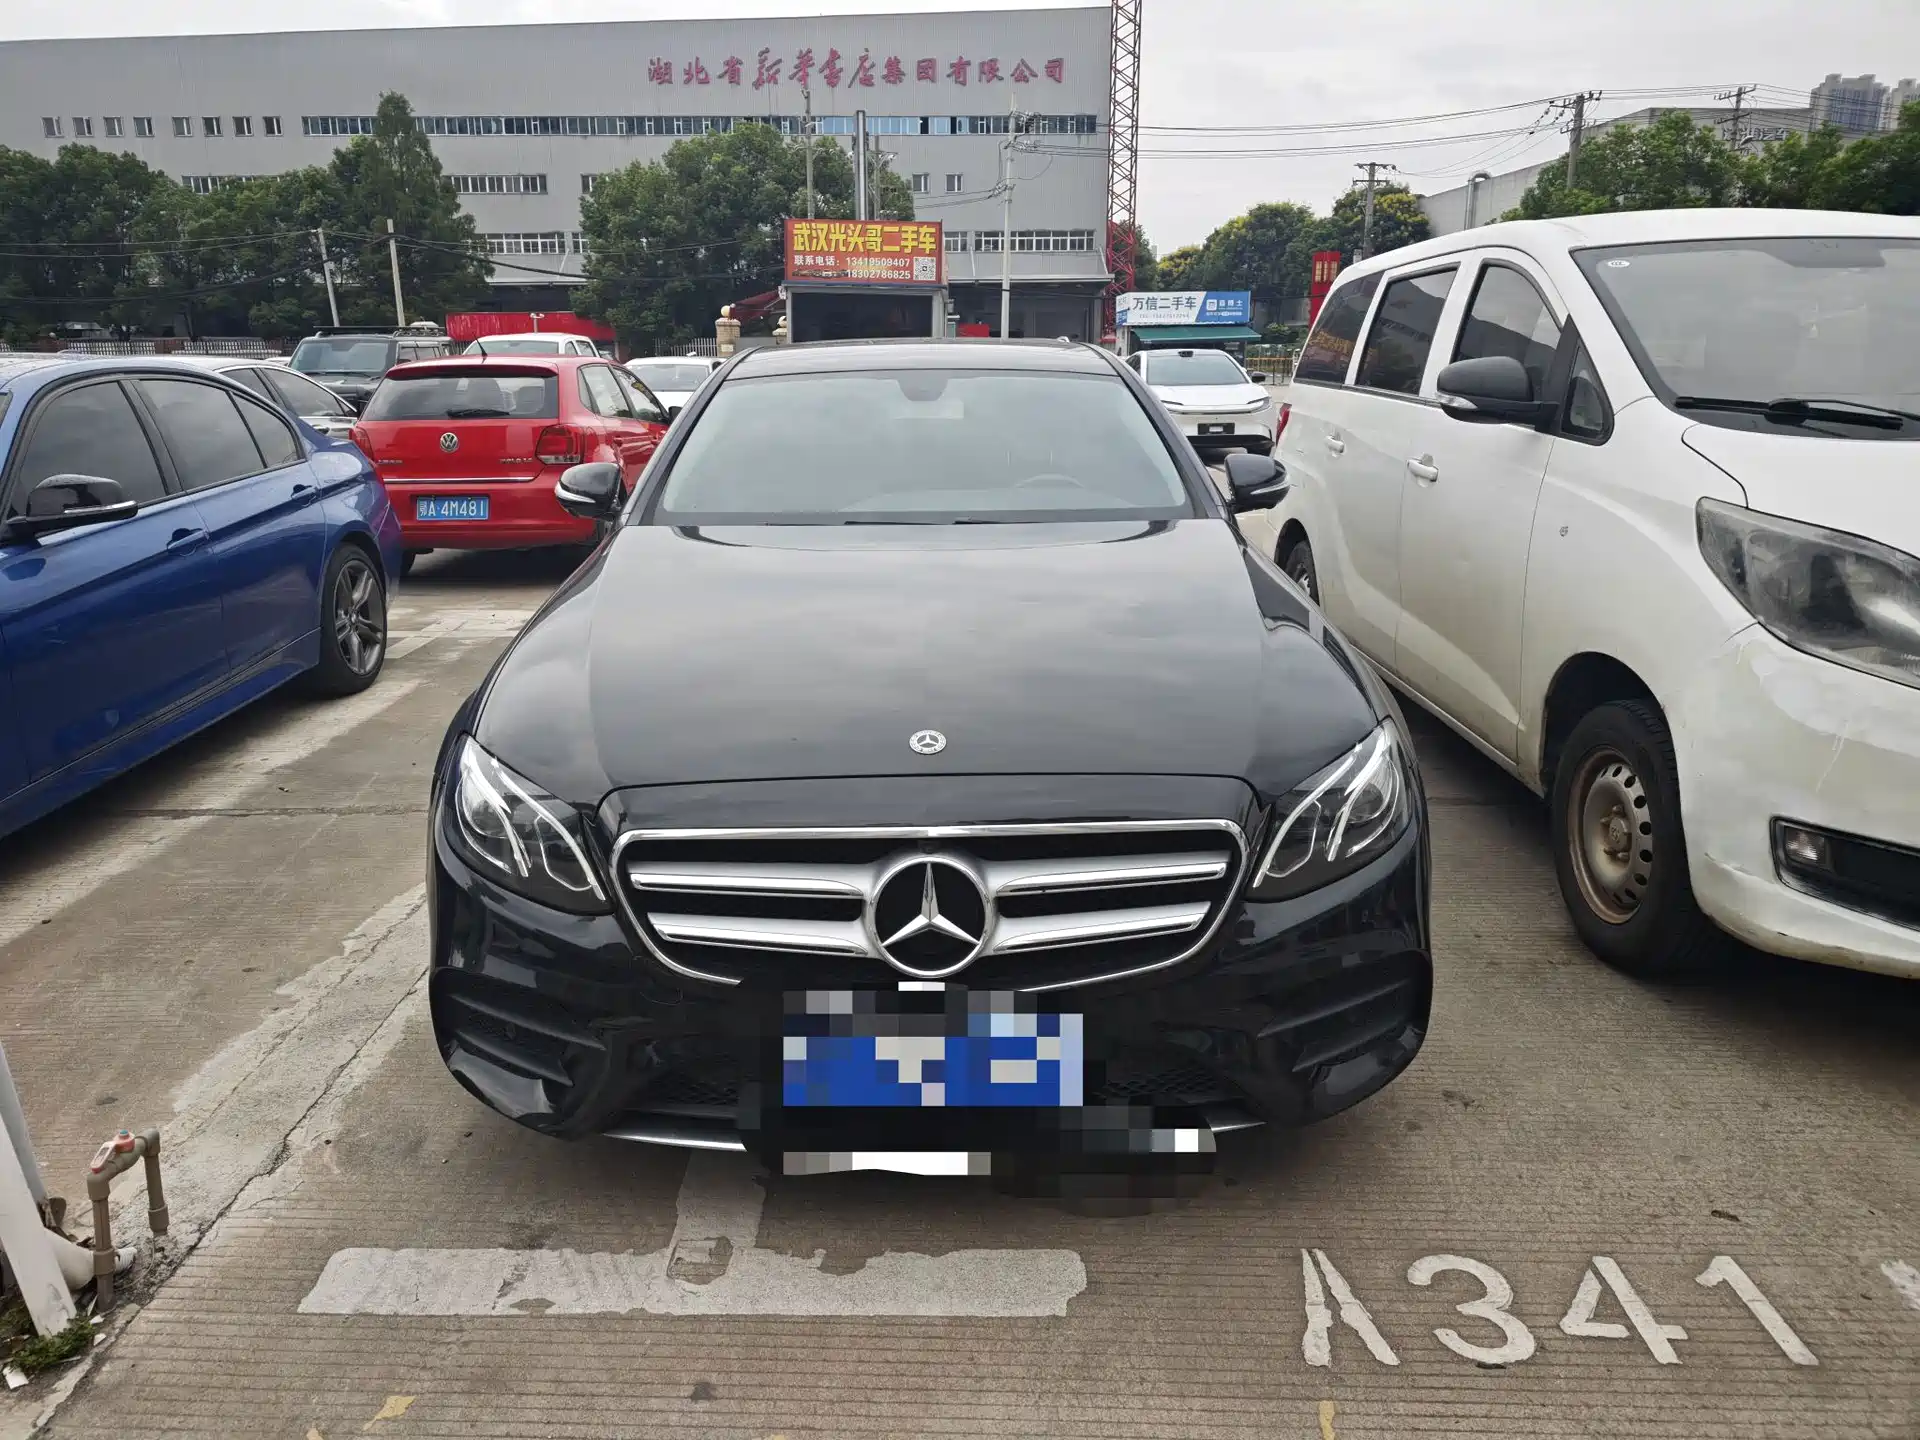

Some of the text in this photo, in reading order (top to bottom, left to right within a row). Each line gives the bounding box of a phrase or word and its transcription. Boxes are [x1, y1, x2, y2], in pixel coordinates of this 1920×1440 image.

[793, 222, 937, 254] 武汉光头哥二手车
[1132, 296, 1197, 311] 万信二手车
[1300, 1247, 1820, 1367] A341
